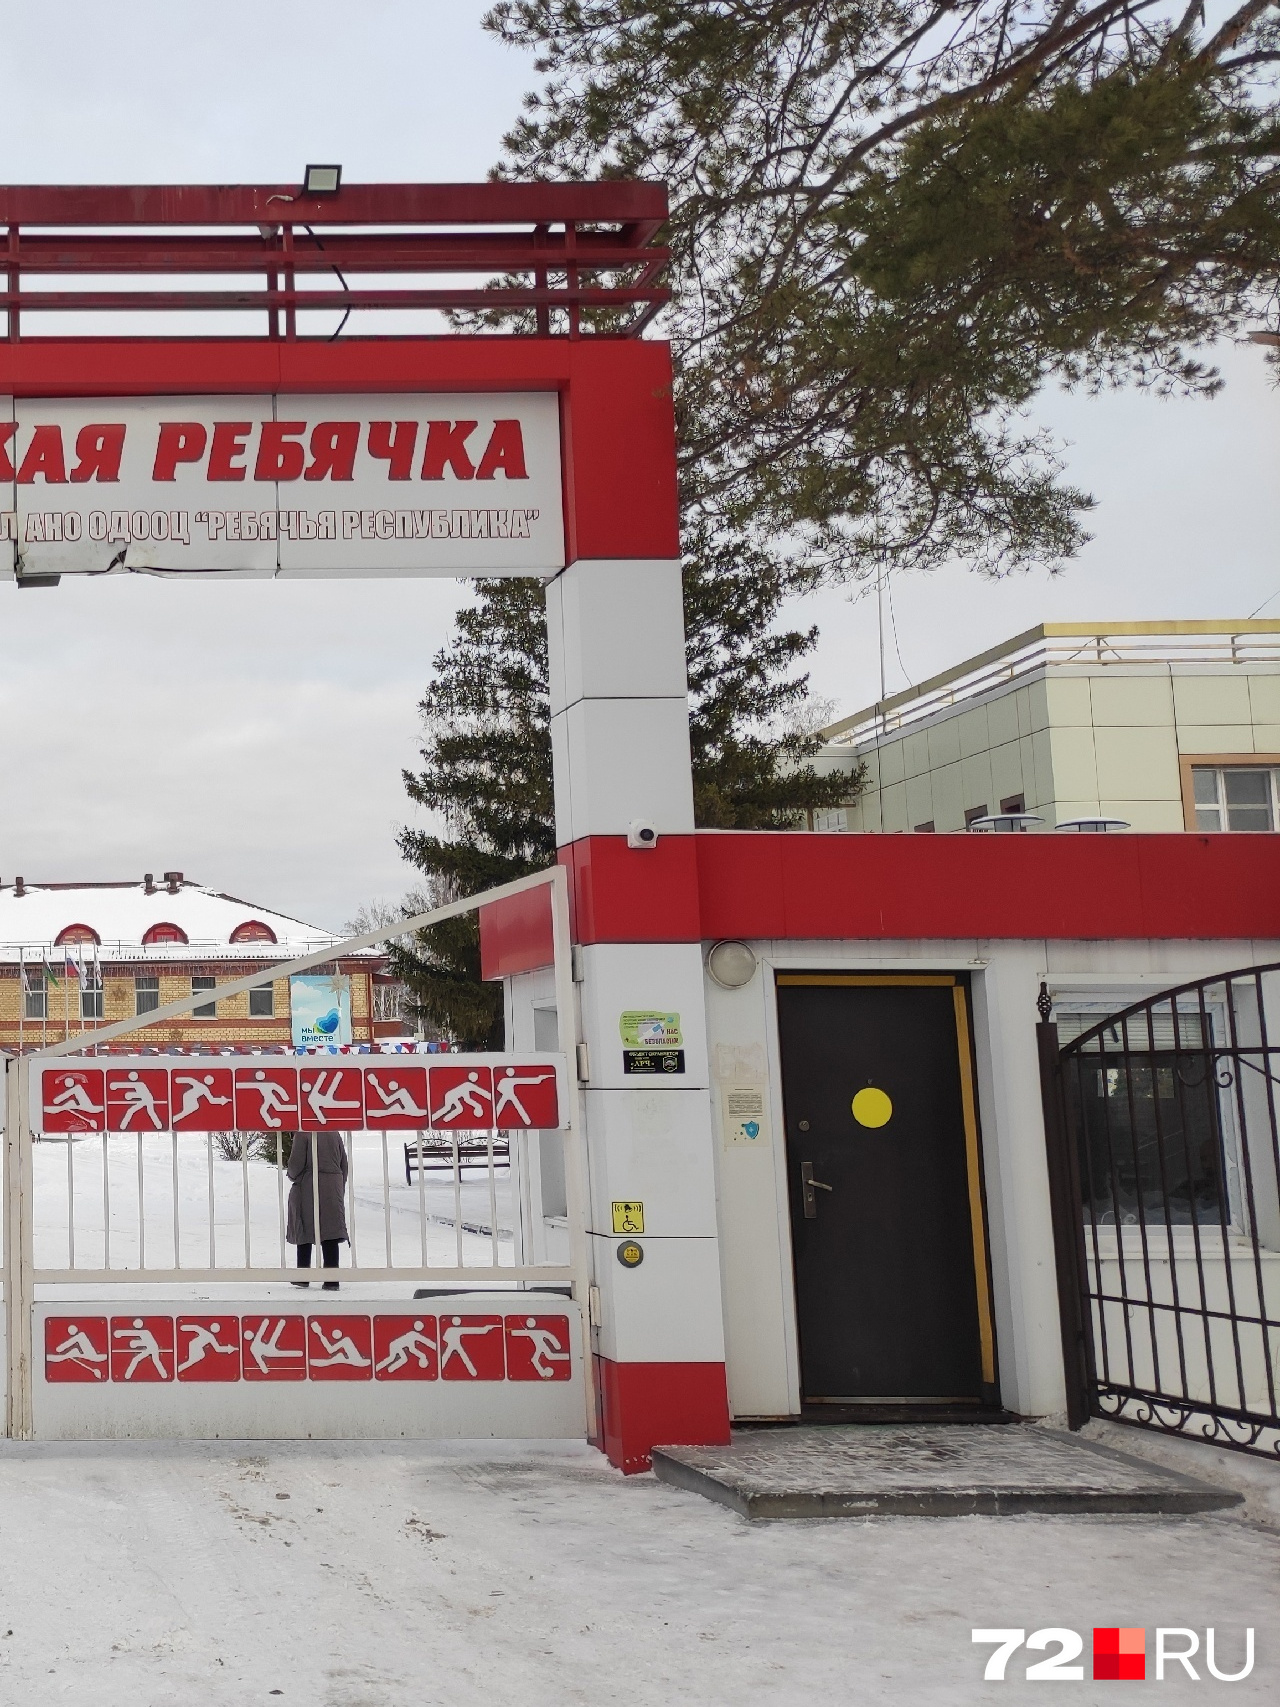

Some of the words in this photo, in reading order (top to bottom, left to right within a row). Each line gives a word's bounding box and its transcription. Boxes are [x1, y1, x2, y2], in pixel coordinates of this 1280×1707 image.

[152, 420, 530, 482] РЕБЯЧКА
[24, 511, 82, 543] АНО
[88, 510, 191, 545] ОДООЦ
